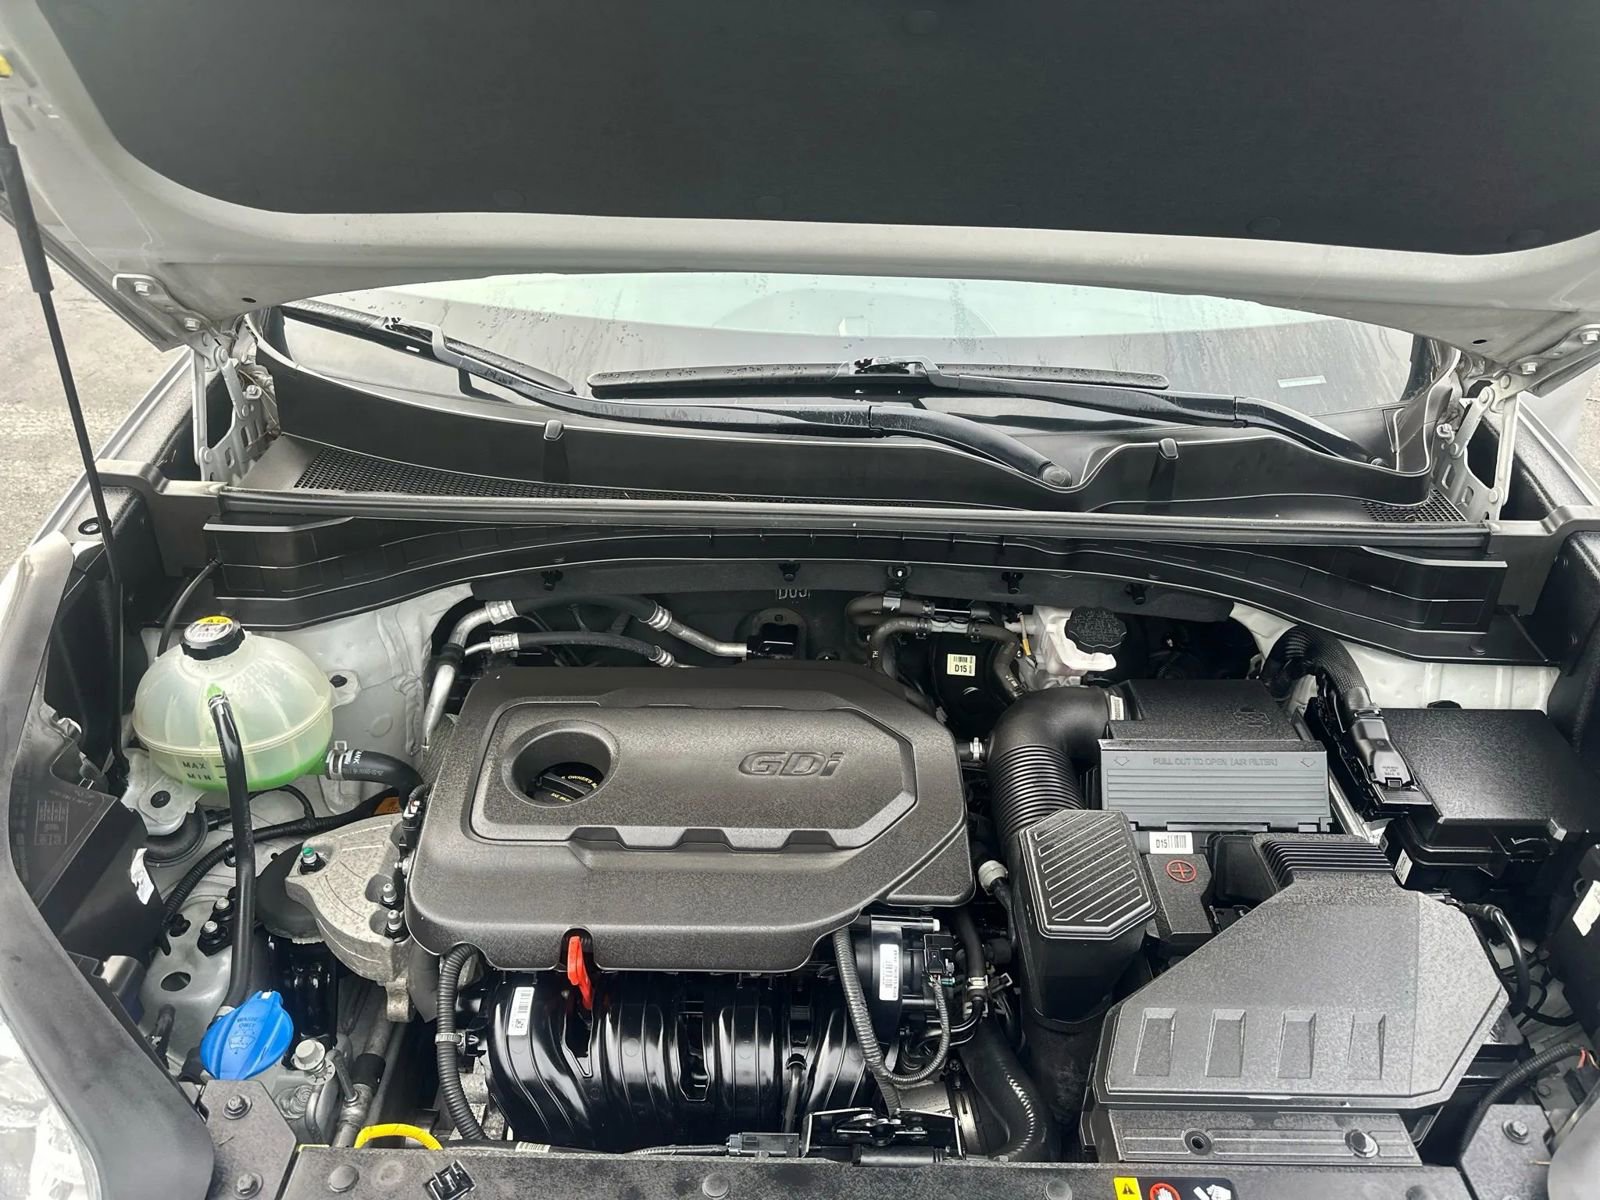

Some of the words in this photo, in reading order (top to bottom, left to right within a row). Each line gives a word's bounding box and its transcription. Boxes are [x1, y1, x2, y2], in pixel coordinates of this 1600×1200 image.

[954, 664, 968, 673] D15
[182, 761, 206, 770] MAX
[738, 751, 844, 776] GDi
[1152, 757, 1174, 766] PULL
[1174, 757, 1192, 766] OUT
[1205, 757, 1228, 766] OPEN
[187, 773, 212, 781] MIN
[1155, 839, 1168, 849] D15
